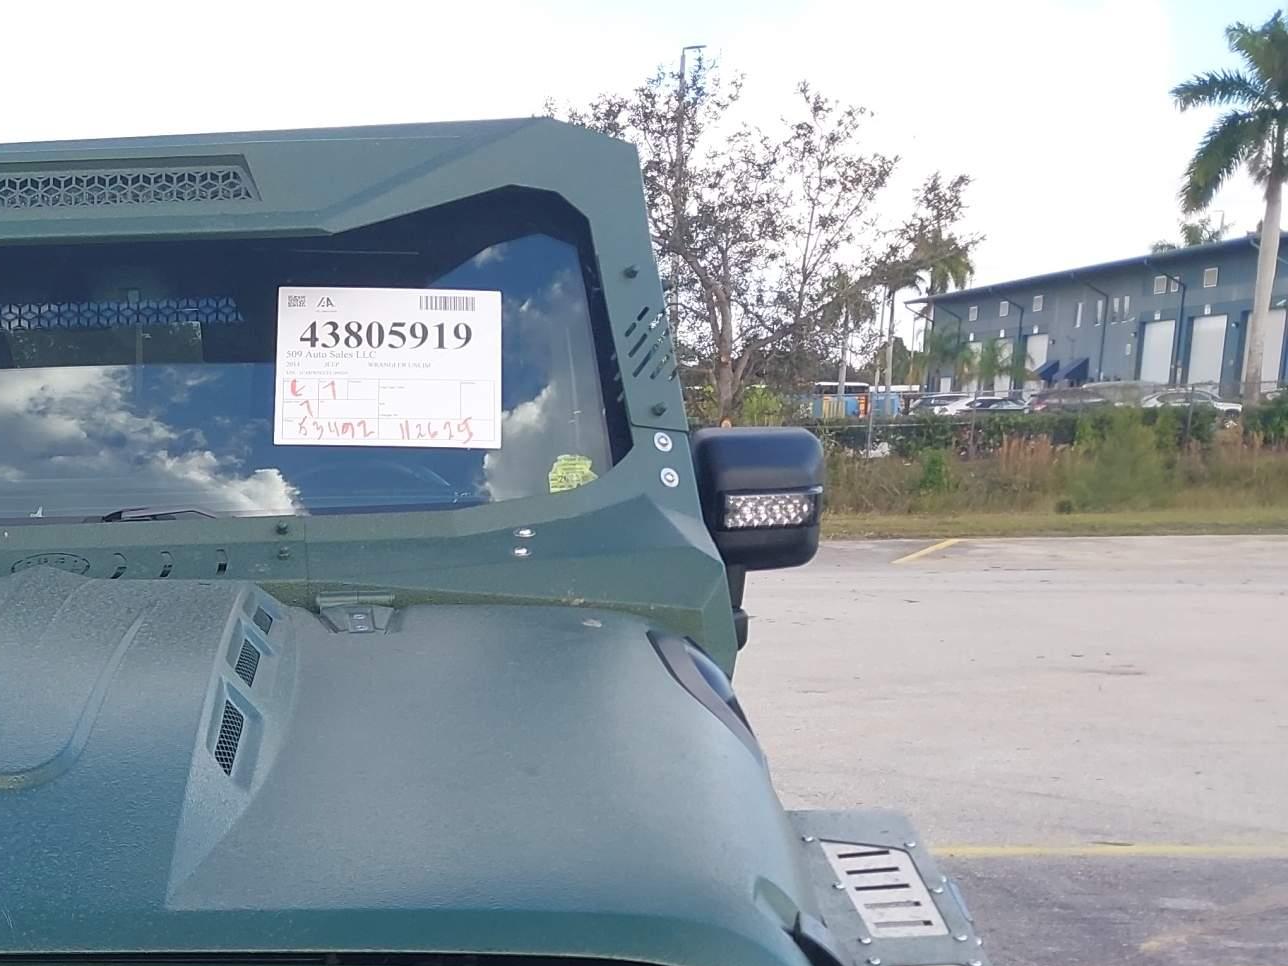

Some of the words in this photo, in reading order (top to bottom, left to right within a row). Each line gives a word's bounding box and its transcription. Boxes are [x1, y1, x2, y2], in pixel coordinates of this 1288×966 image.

[300, 320, 473, 350] 43805919
[285, 350, 303, 359] 509
[305, 350, 327, 359] Auto
[329, 350, 354, 359] Sales
[355, 350, 377, 359] LLC
